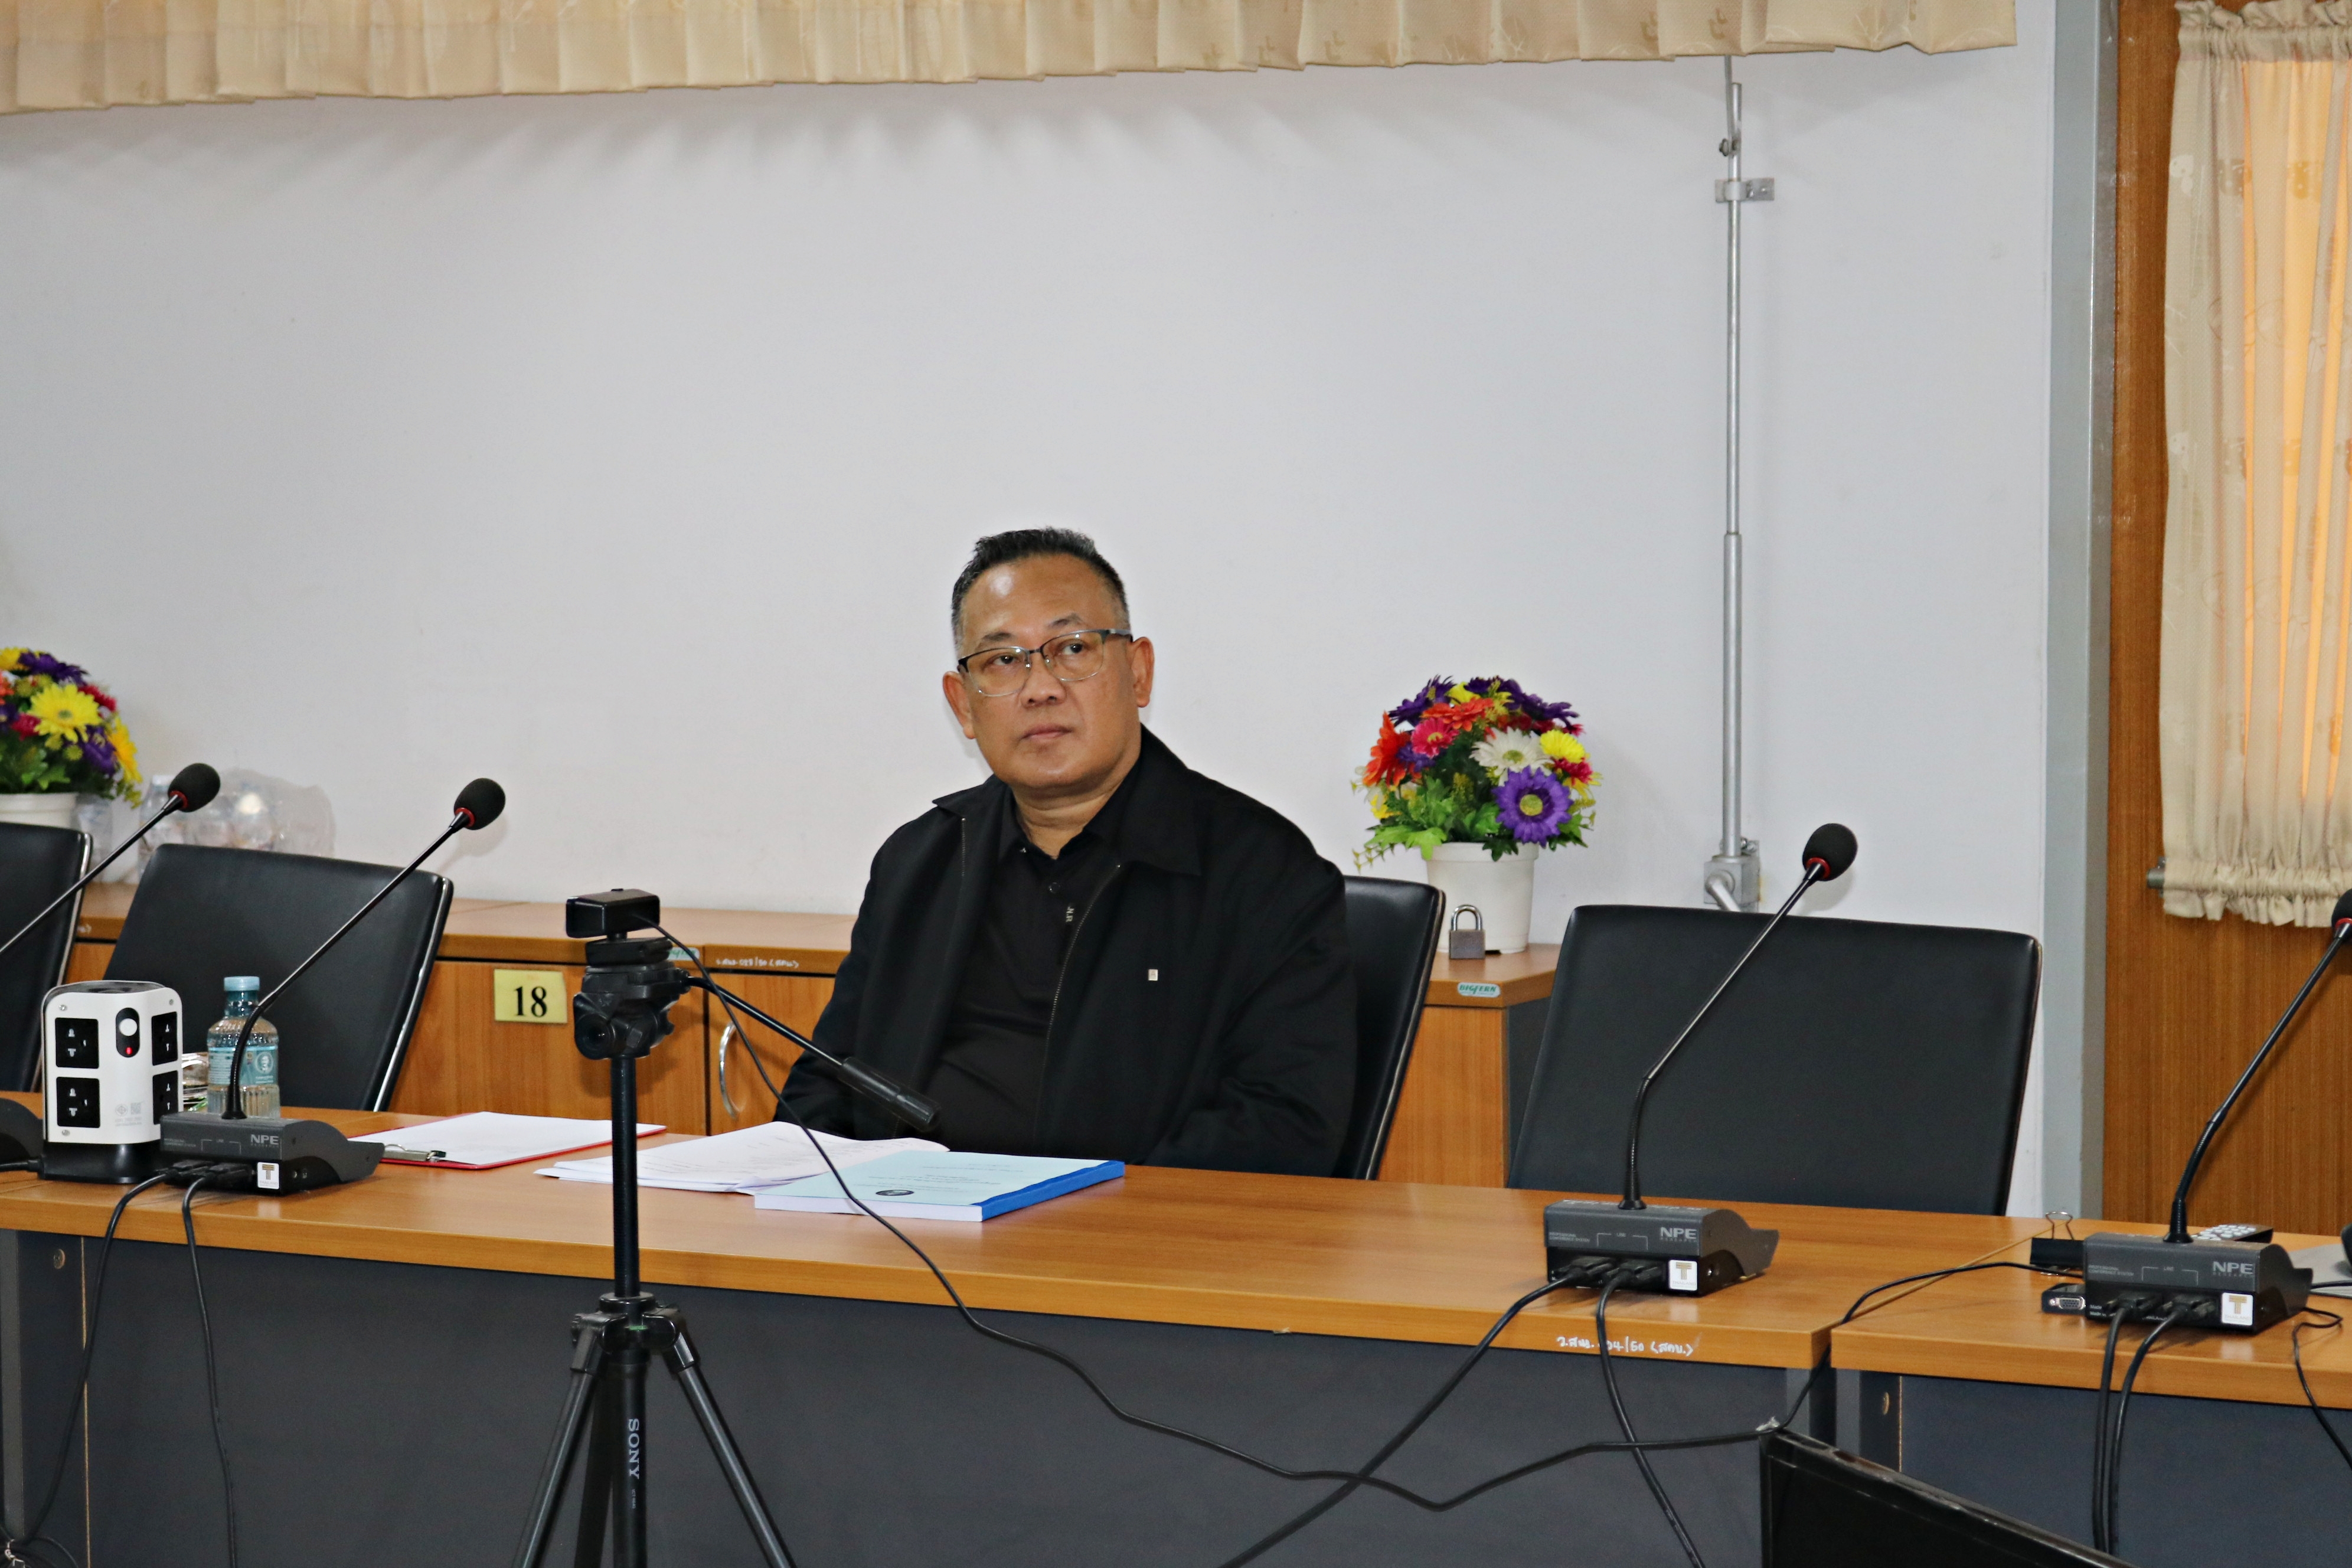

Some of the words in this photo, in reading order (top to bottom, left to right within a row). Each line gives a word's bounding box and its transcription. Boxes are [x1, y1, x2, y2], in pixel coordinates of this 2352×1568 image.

[514, 985, 547, 1018] 18
[250, 1134, 279, 1145] NPE
[1661, 1227, 1697, 1239] NPE
[2213, 1261, 2253, 1275] NPE
[628, 1418, 640, 1480] SONY
